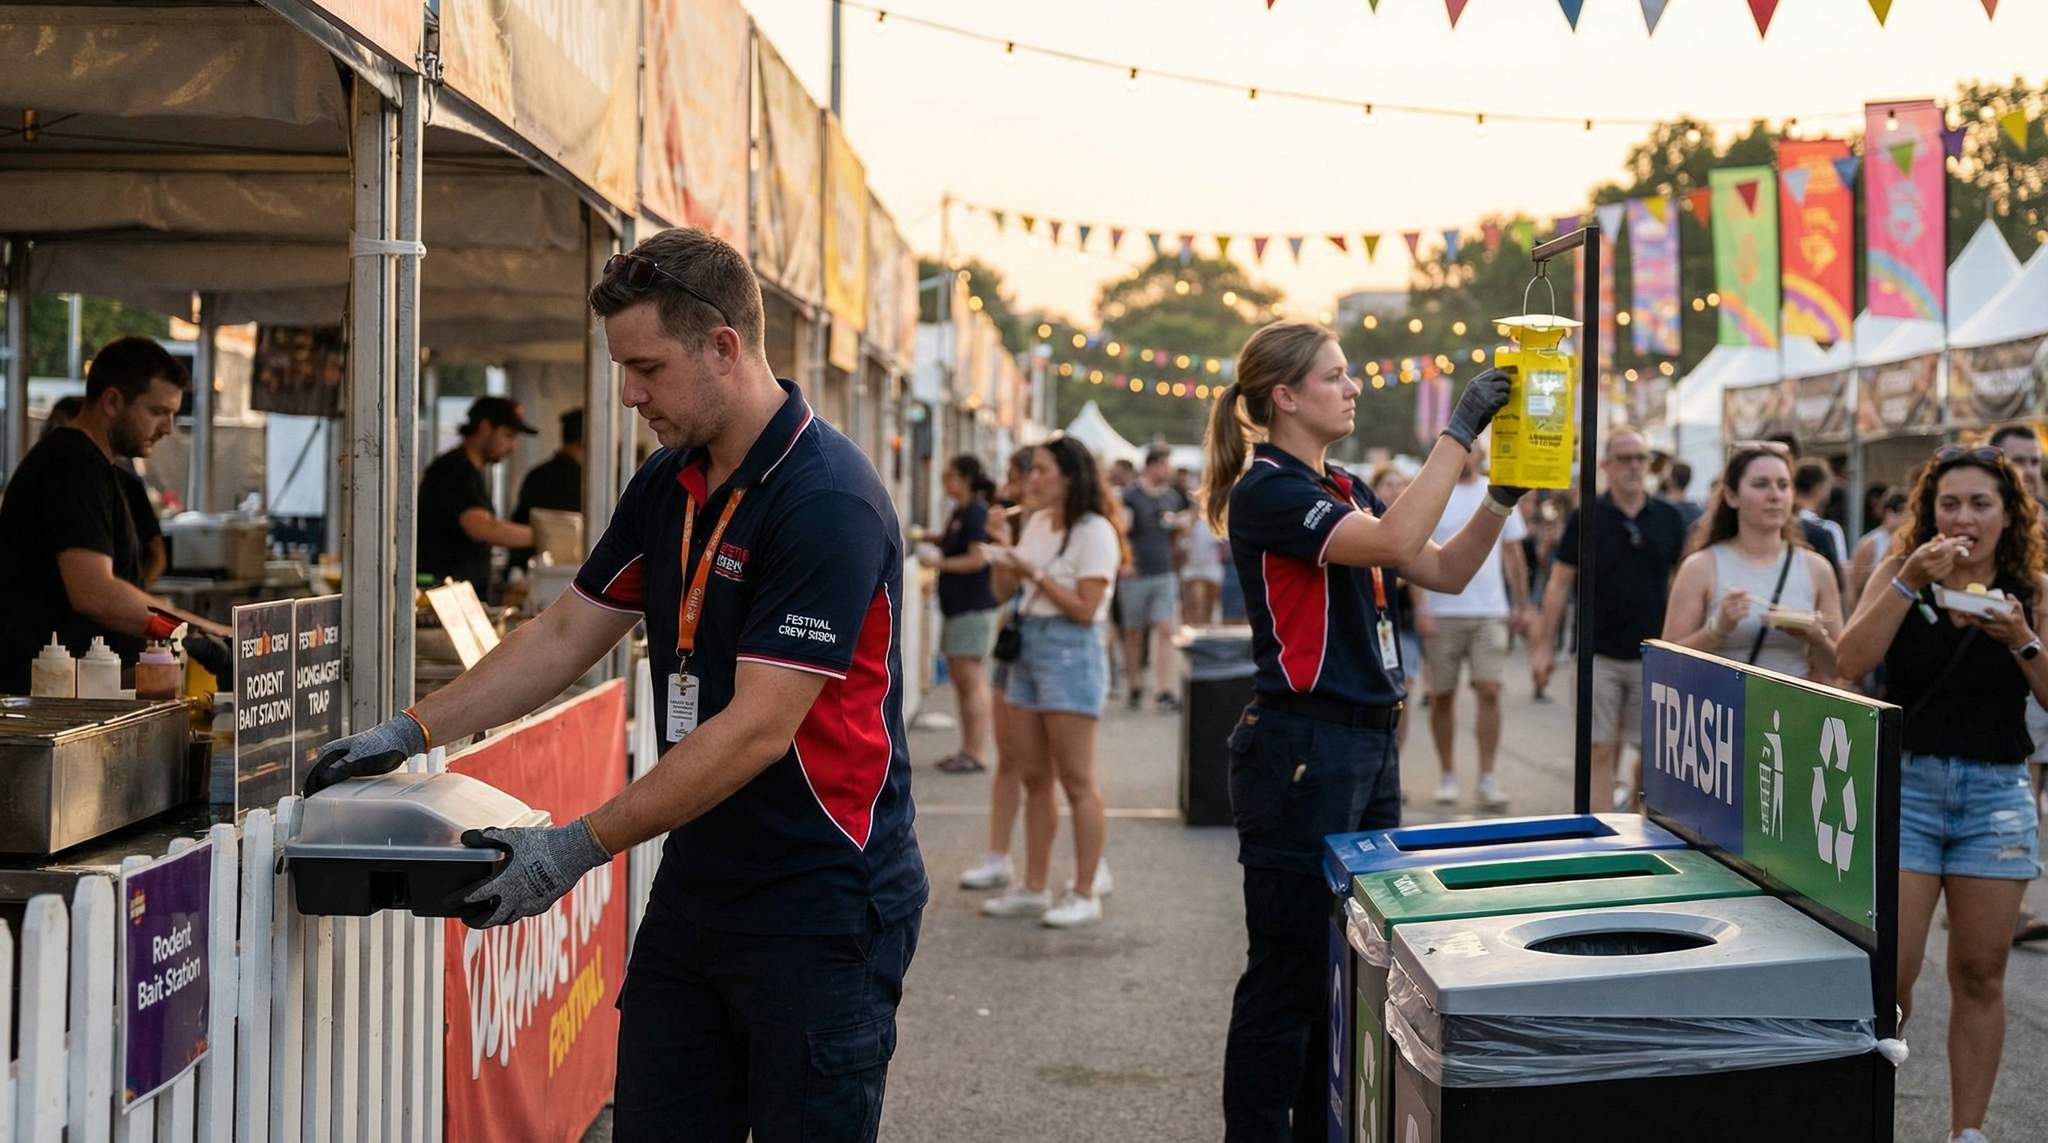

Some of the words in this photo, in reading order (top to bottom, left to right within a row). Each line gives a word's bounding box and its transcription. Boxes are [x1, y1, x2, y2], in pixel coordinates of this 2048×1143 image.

[778, 624, 807, 639] CREW
[785, 613, 832, 631] FESTIVAL
[246, 670, 285, 700] RODENT
[239, 706, 258, 730] BAIT
[259, 698, 291, 726] STATION
[308, 689, 330, 716] TRAP
[1651, 682, 1734, 806] TRASH
[152, 921, 192, 965] Rodent
[137, 975, 164, 1011] Bait
[165, 956, 201, 998] Station
